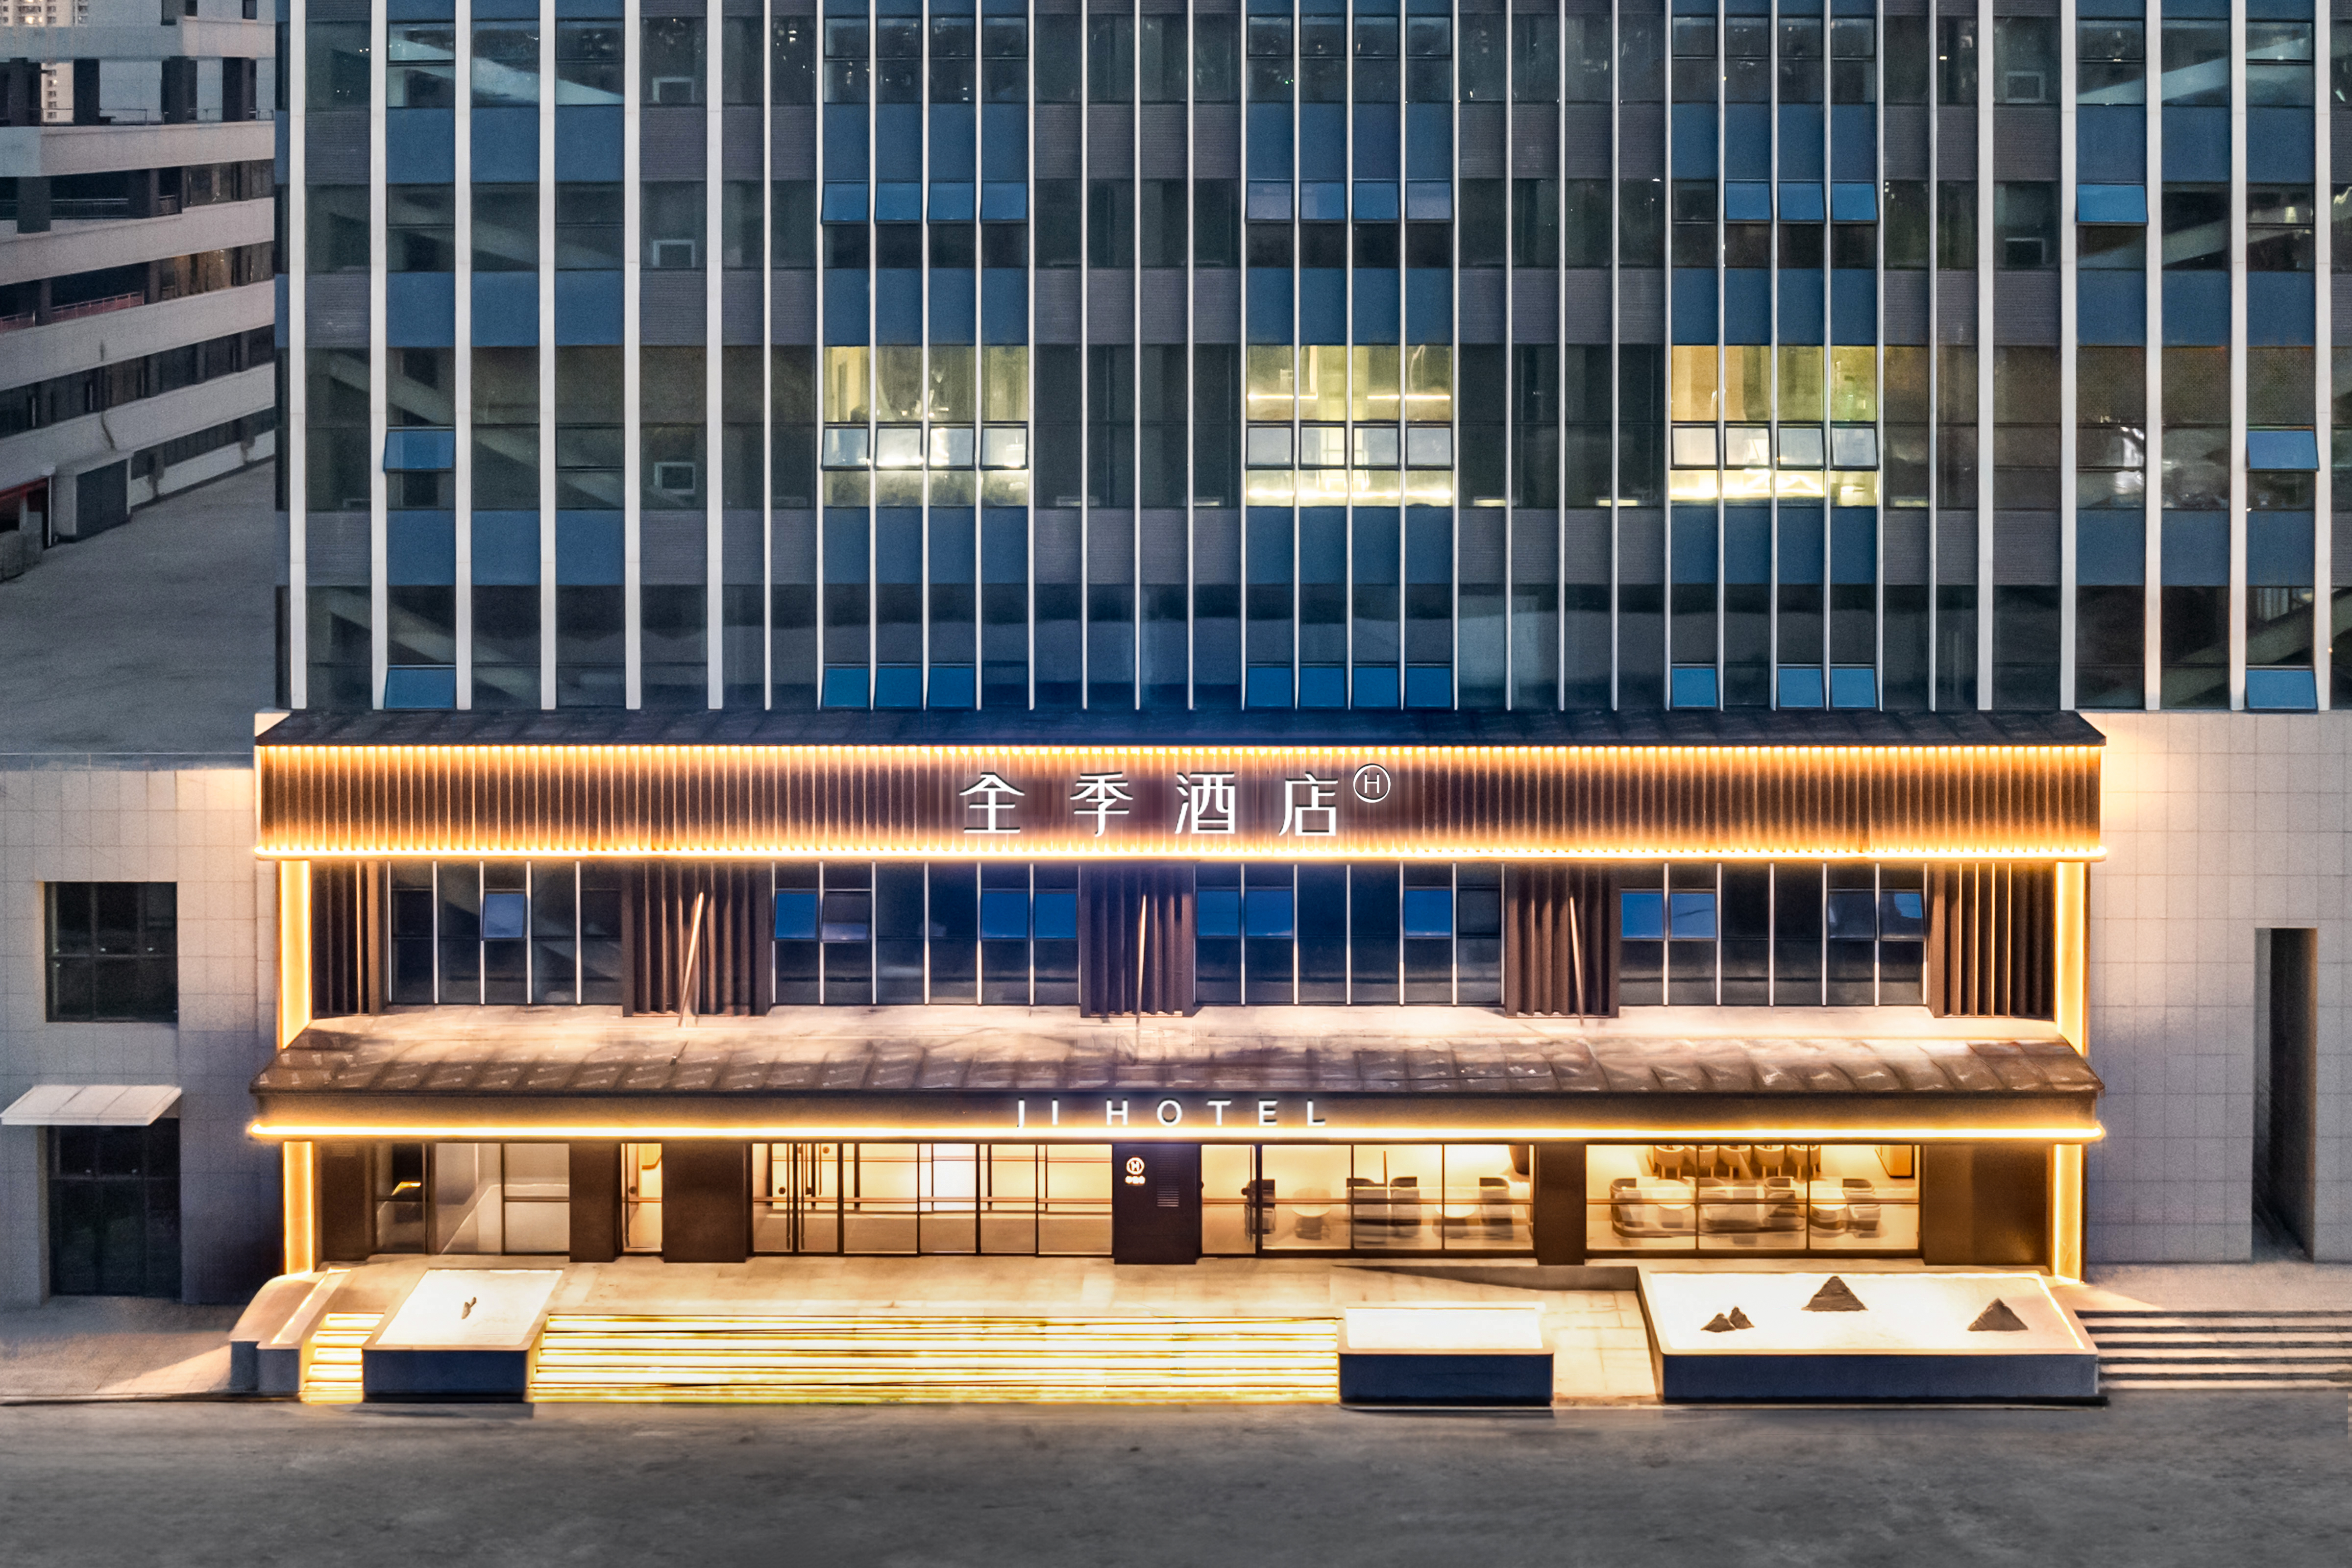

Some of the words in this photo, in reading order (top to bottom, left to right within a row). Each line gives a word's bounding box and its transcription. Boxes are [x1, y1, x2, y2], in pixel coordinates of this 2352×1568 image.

[959, 771, 1338, 837] 全季酒店
[1017, 1098, 1058, 1127] JI
[1106, 1098, 1325, 1127] HOTEL
